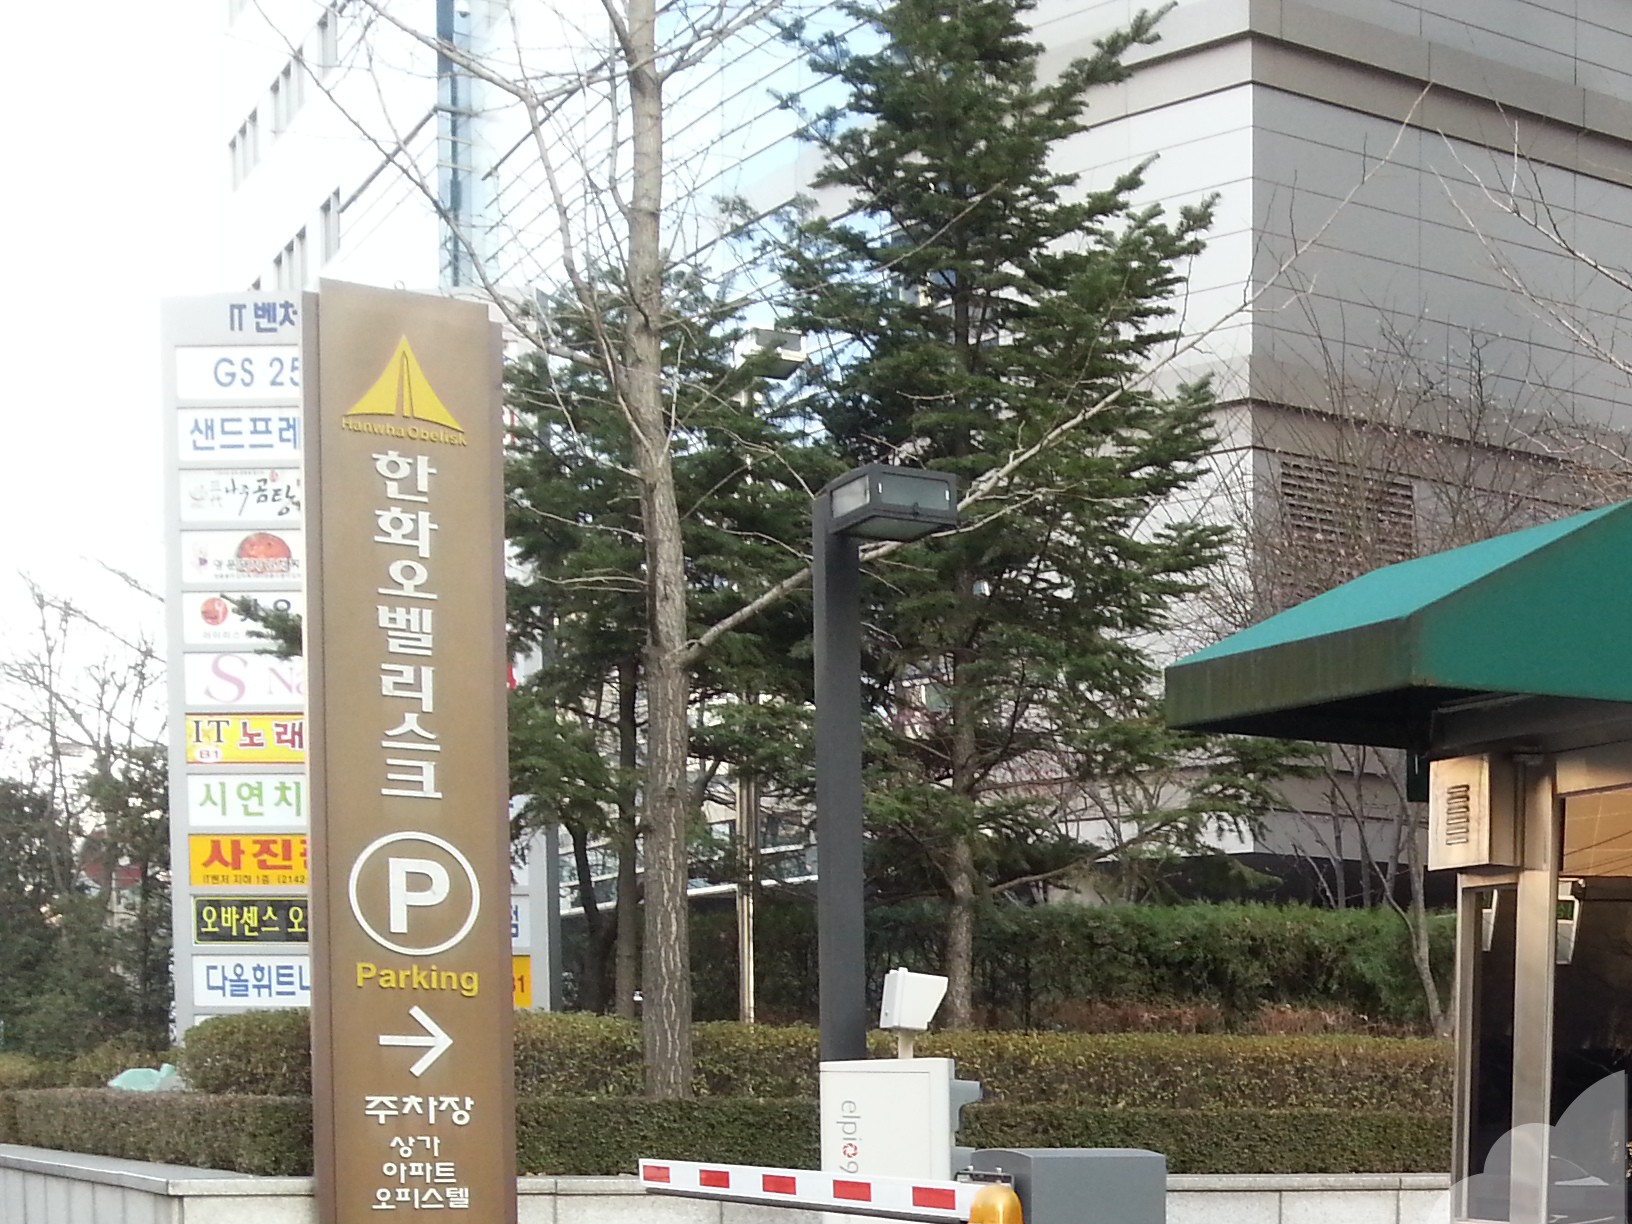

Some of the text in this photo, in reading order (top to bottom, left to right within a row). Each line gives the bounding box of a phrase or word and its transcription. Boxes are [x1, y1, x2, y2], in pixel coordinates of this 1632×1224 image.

[229, 303, 247, 331] IT
[213, 357, 255, 388] GS
[341, 416, 467, 447] Hanwha Obelisk
[372, 450, 443, 799] 한화오벨리스크
[204, 653, 248, 703] S
[192, 719, 230, 744] IT
[199, 749, 219, 760] B1
[199, 780, 302, 818] 시연치
[388, 857, 450, 934] P
[201, 905, 280, 936] 오바센스
[356, 962, 480, 997] Parking
[365, 1095, 475, 1126] 주차장
[389, 1136, 441, 1158] 상가
[382, 1162, 457, 1184] 아파트
[371, 1187, 470, 1209] 오피스텔
